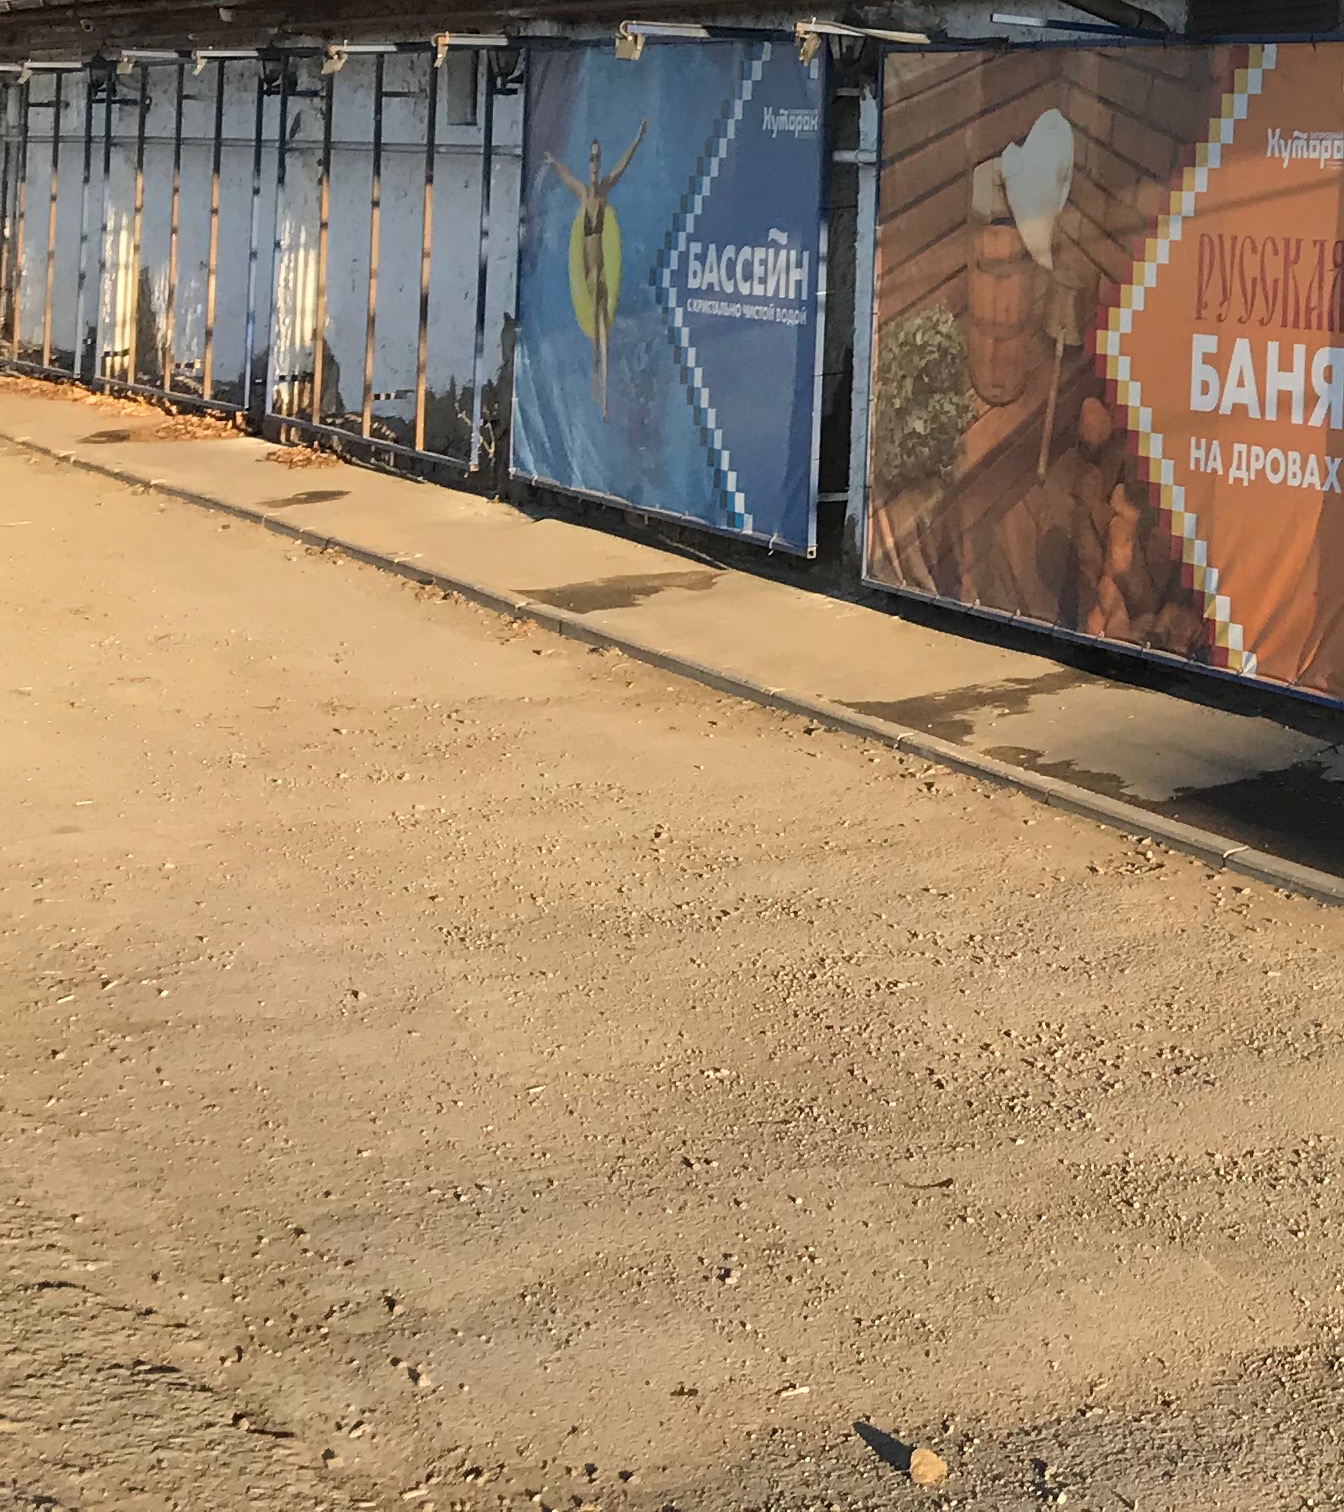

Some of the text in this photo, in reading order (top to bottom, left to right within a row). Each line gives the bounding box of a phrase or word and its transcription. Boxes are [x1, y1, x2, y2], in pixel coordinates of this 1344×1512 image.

[687, 228, 810, 300] БАССЕЙН
[1190, 436, 1343, 494] НА ДРОВАХ
